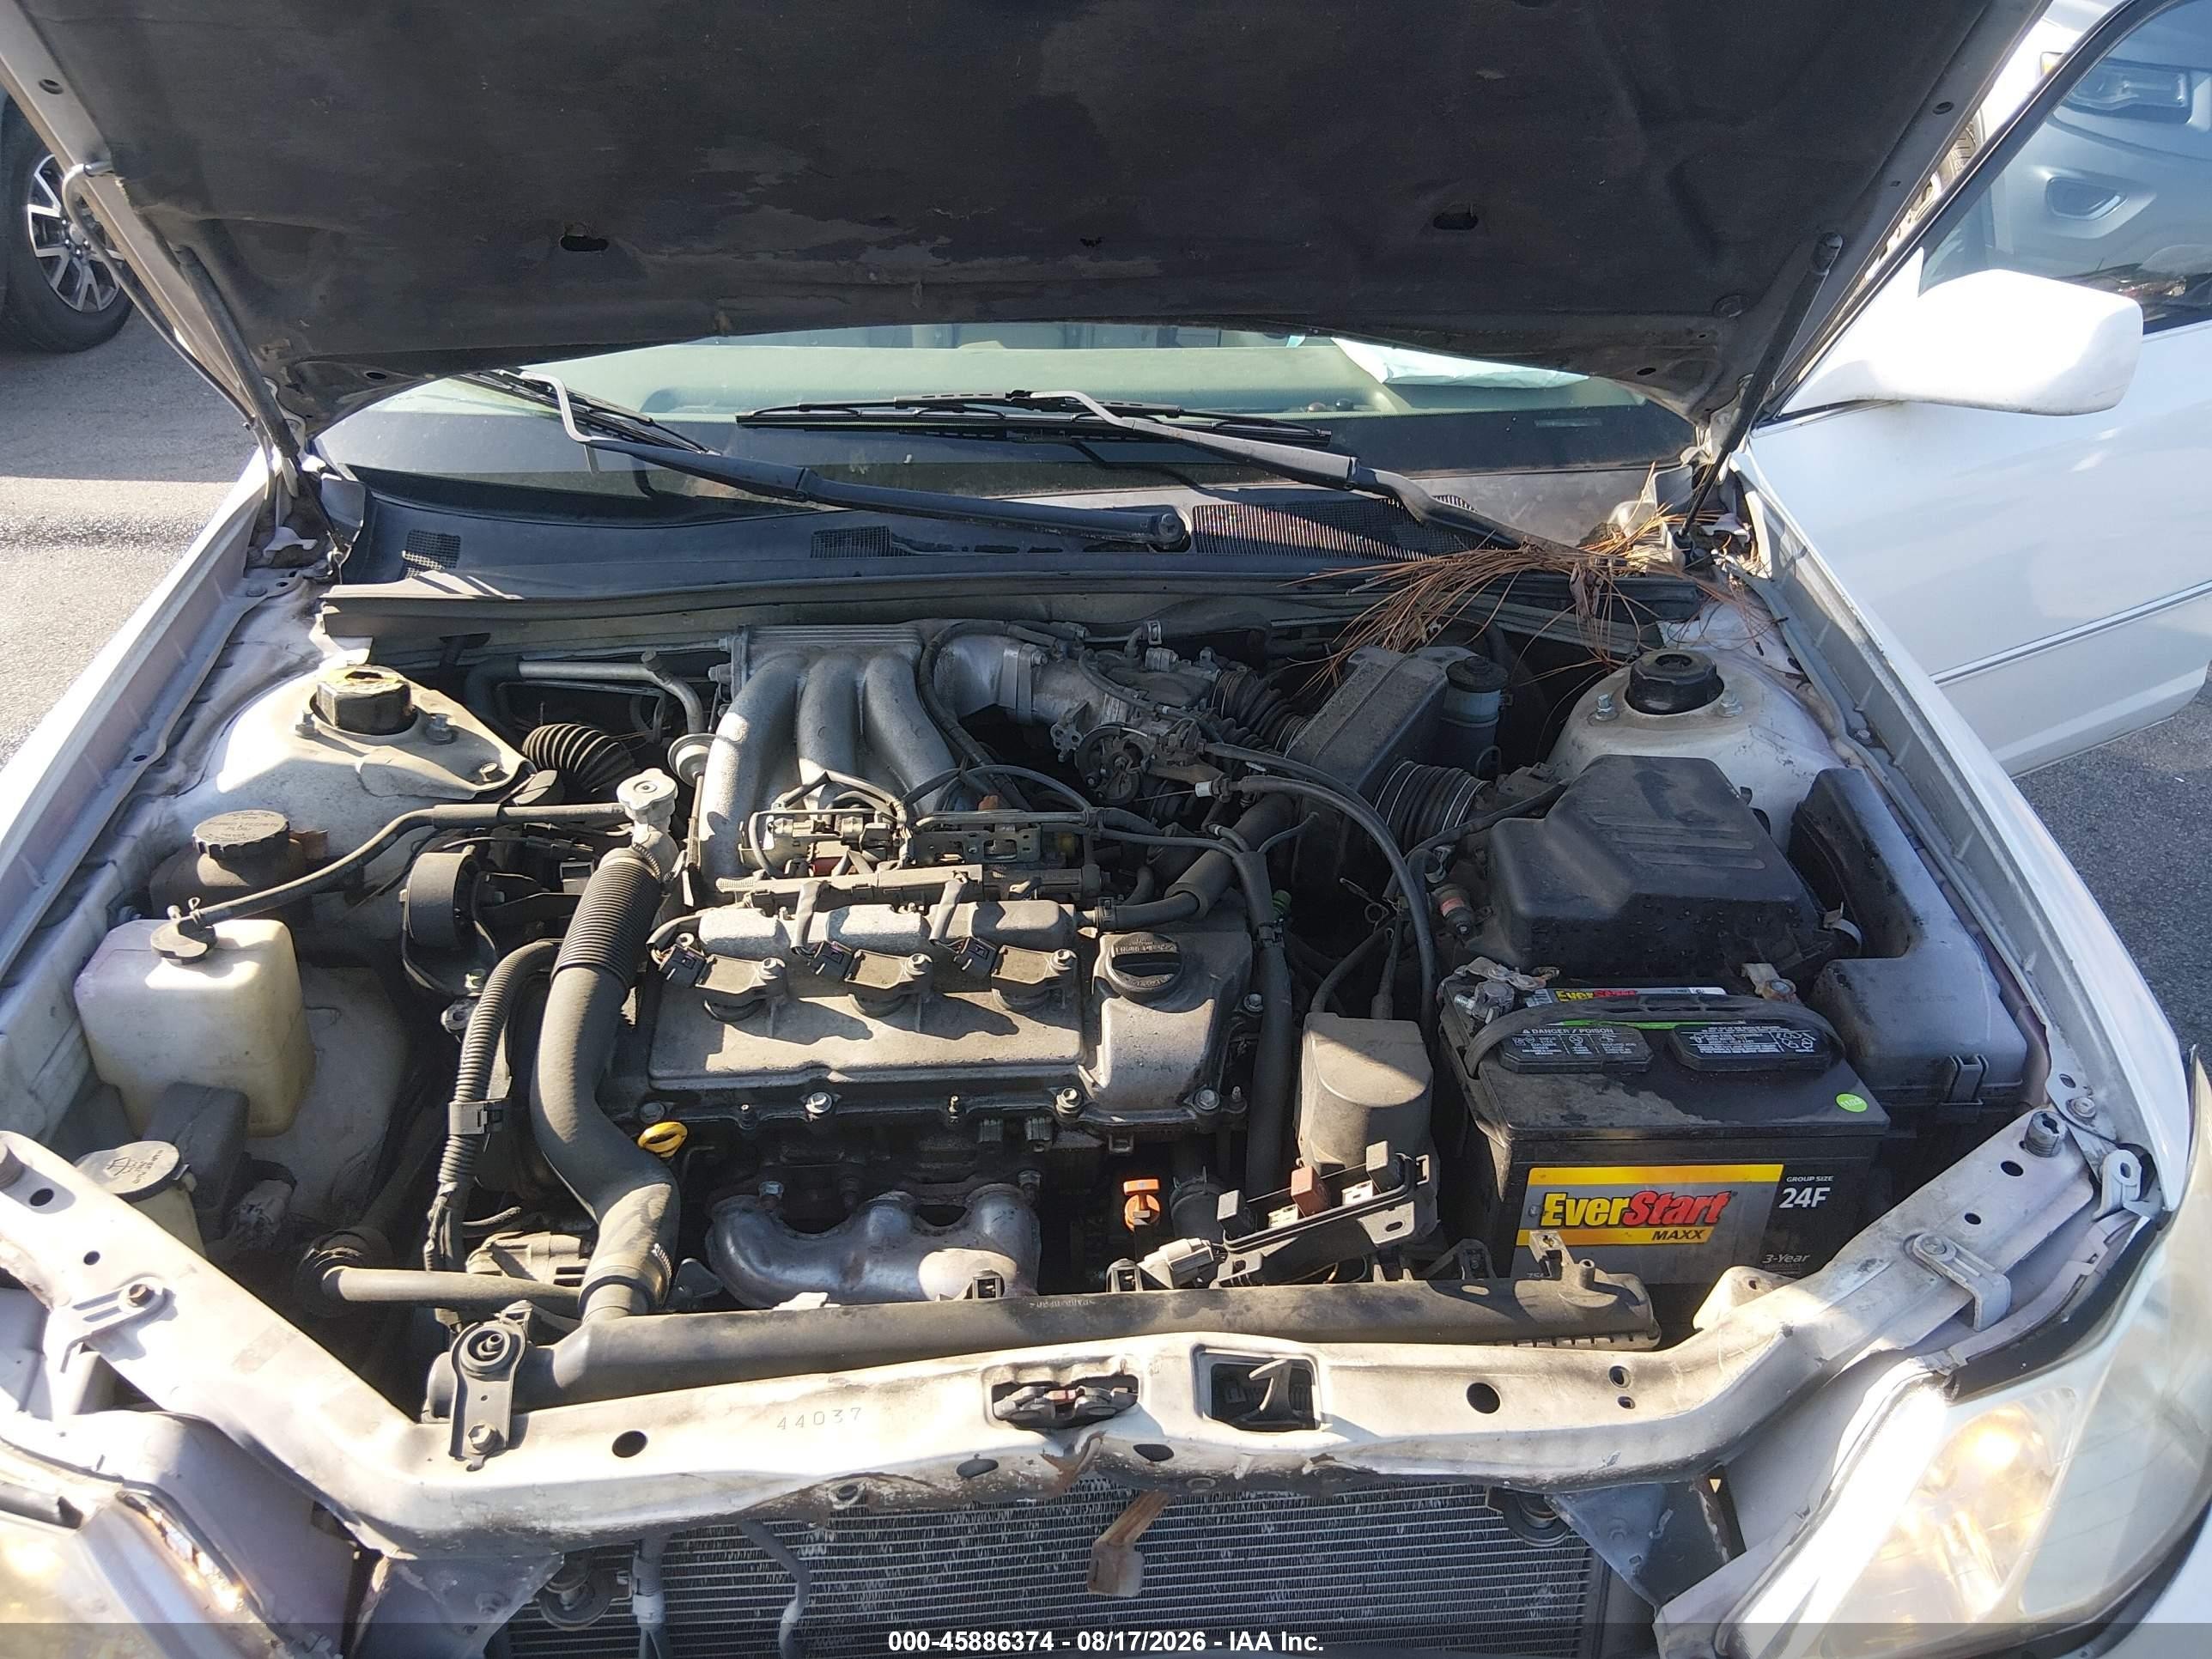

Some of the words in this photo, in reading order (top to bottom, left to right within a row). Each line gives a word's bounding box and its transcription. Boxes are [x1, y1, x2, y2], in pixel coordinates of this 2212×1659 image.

[1540, 1190, 1732, 1228] EverStart
[1778, 1187, 1831, 1209] 24F
[1650, 1229, 1705, 1241] MAXX
[1761, 1254, 1811, 1264] 3-Year
[776, 1407, 861, 1430] 44037
